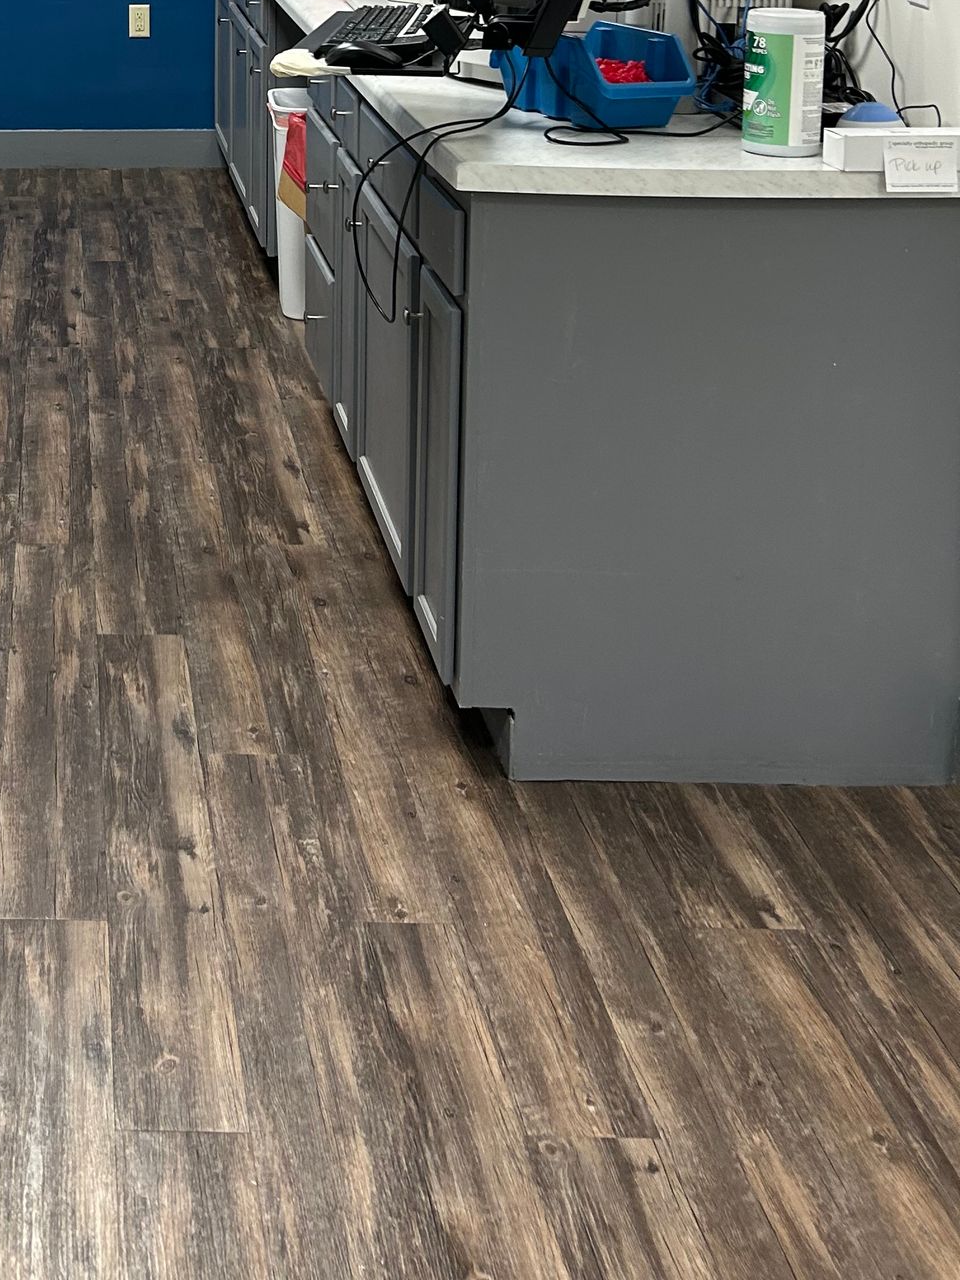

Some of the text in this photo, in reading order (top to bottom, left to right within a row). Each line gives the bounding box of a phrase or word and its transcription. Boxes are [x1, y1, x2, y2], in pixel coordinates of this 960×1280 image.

[753, 36, 766, 48] 78
[889, 158, 942, 175] Pick up
